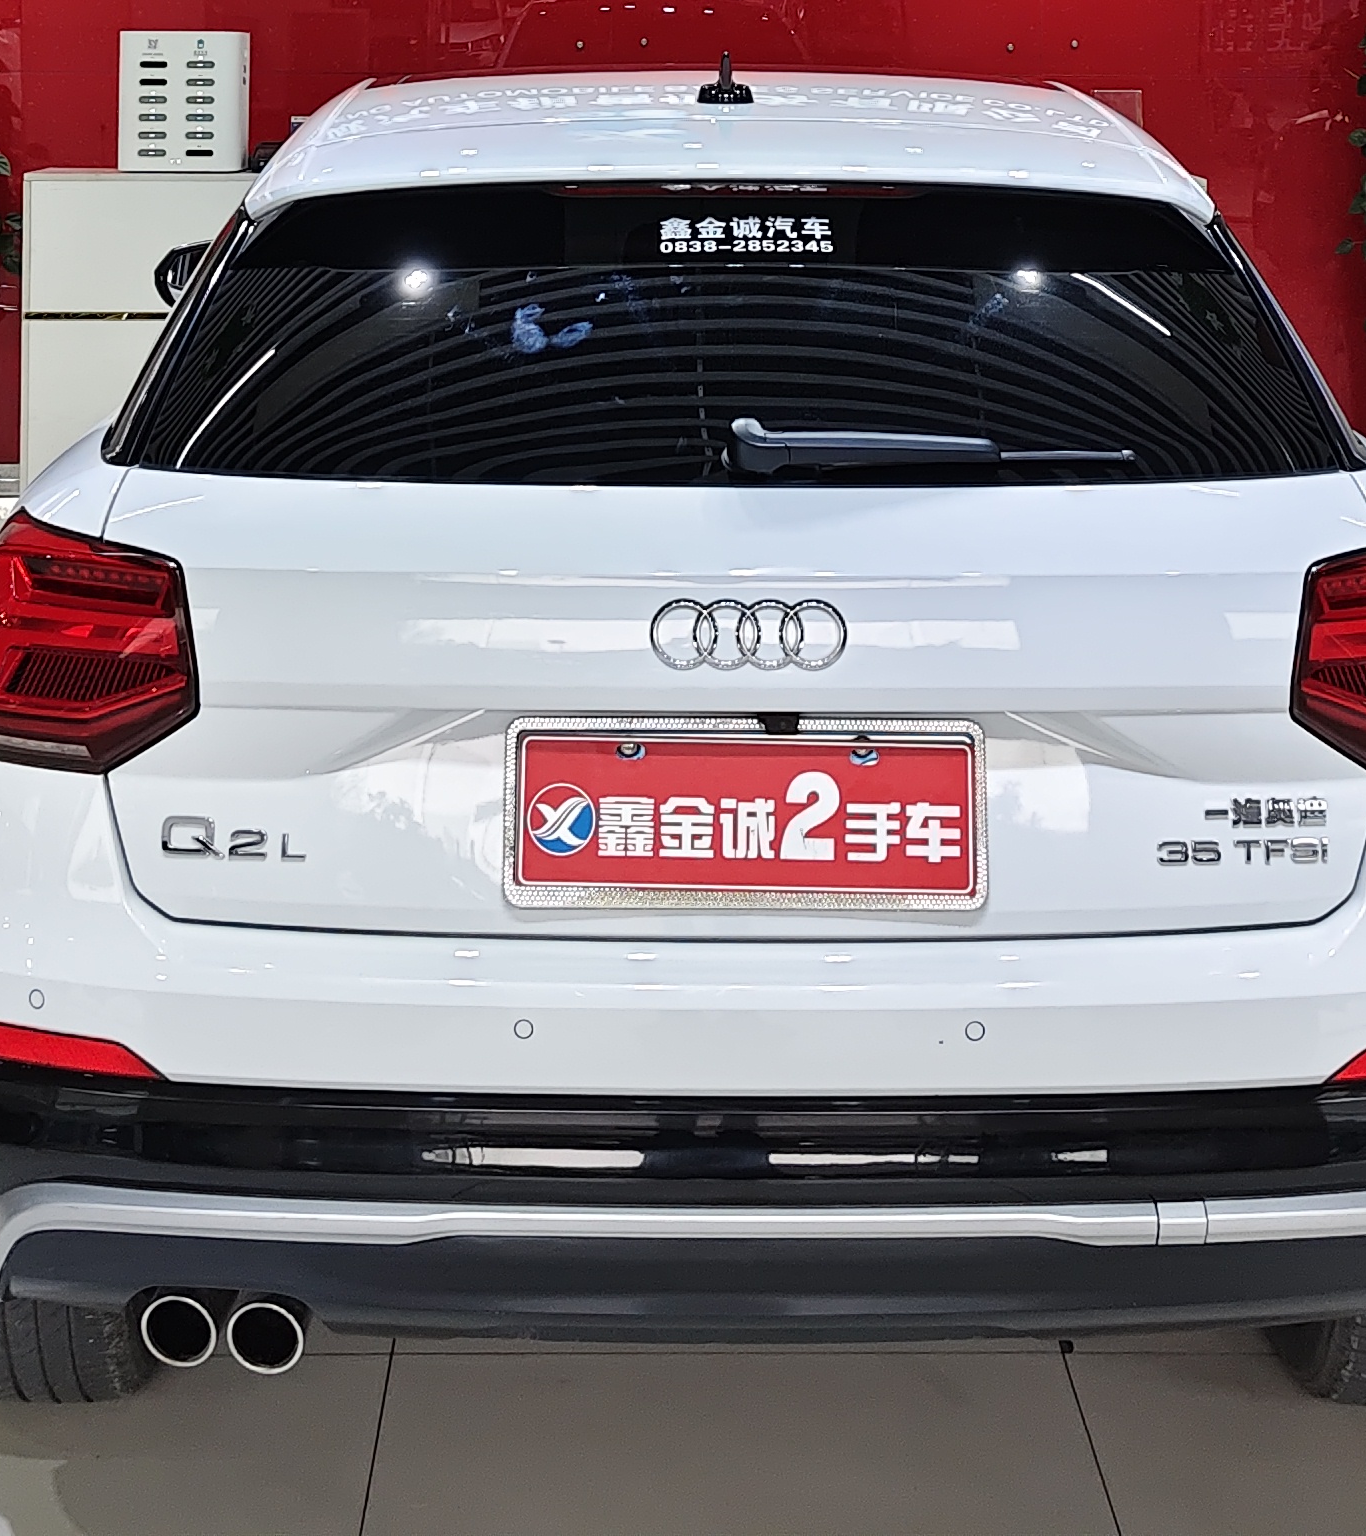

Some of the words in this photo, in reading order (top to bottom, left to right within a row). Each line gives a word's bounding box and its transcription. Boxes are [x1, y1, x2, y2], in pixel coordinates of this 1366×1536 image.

[659, 216, 832, 240] 鑫金诚汽车
[659, 240, 834, 254] 0838-2852345
[597, 771, 962, 863] 鑫金诚2手车
[1157, 839, 1222, 866] 35
